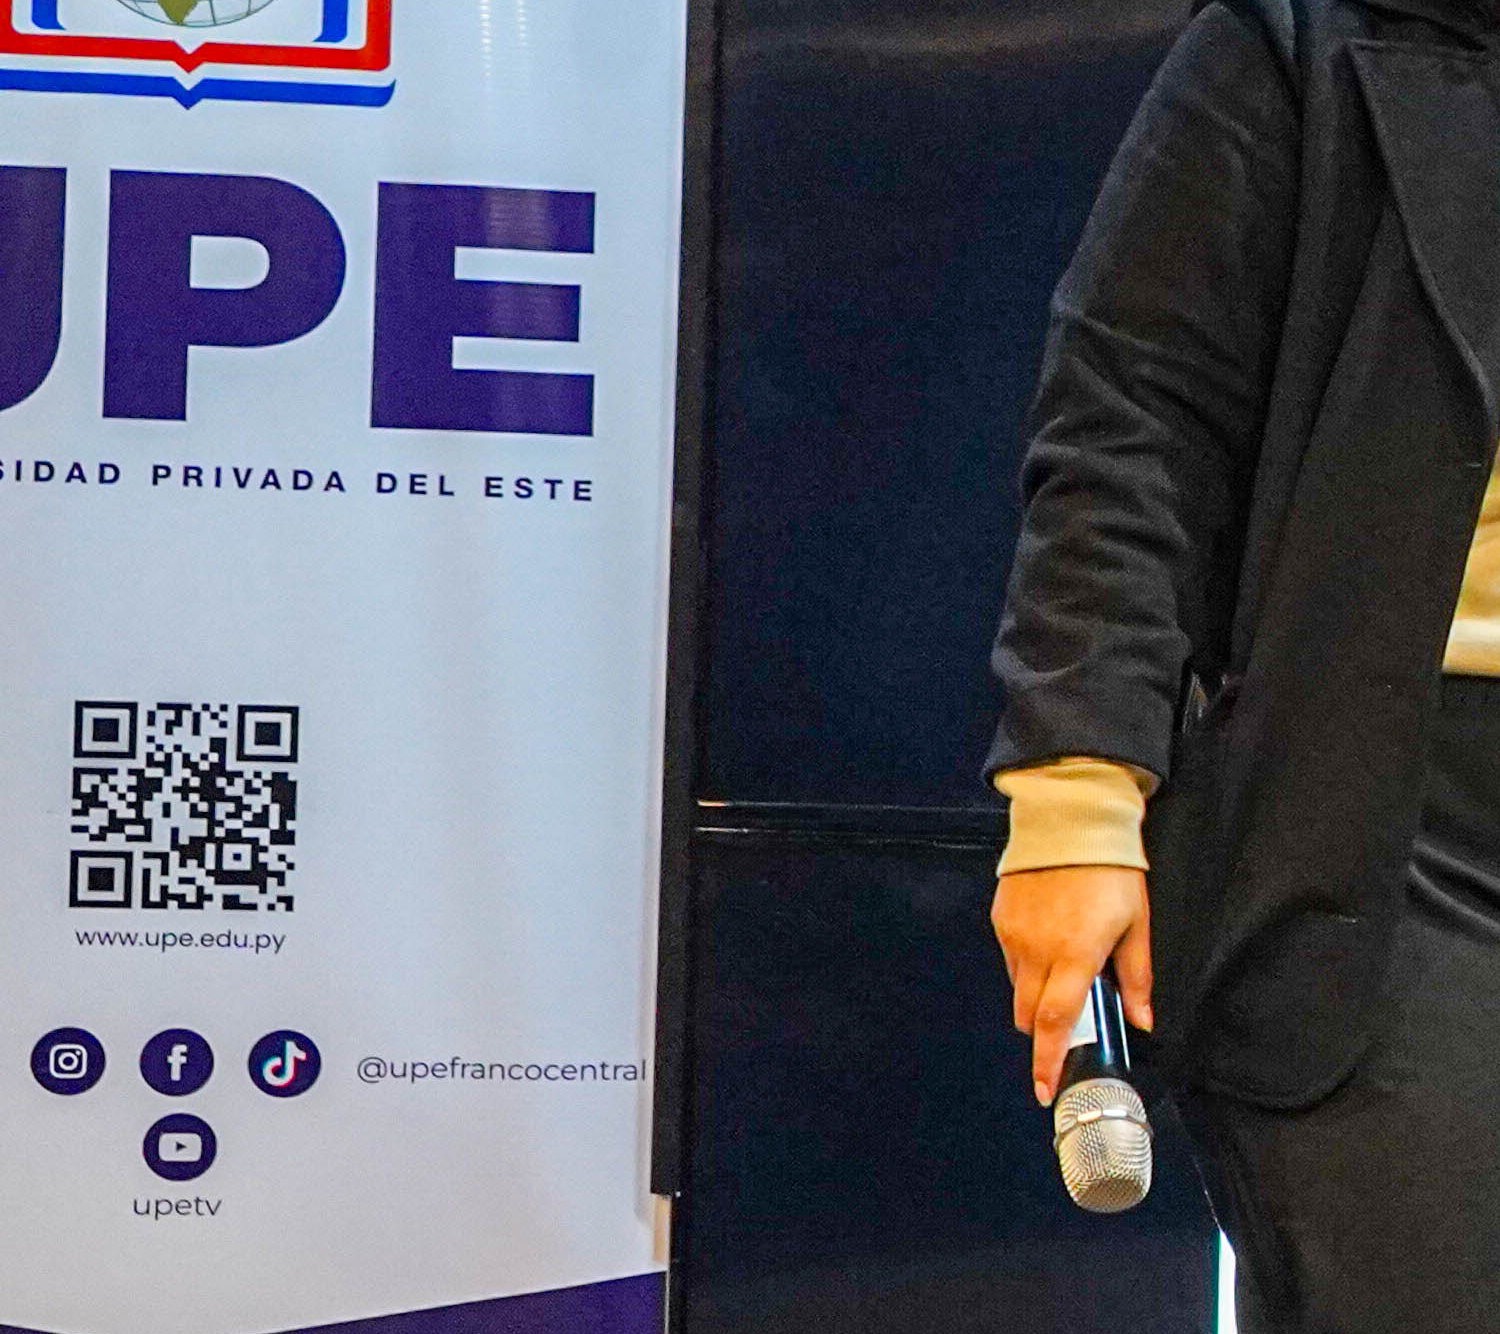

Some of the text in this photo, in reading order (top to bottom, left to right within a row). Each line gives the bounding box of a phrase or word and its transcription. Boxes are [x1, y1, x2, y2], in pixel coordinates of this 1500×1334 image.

[0, 165, 596, 437] PE
[0, 459, 594, 502] IDAD PRIVADA DEL ESTE
[75, 928, 287, 954] www.upe.edu.py
[355, 1055, 649, 1085] @upefrancocentral
[132, 1193, 223, 1221] upetv
